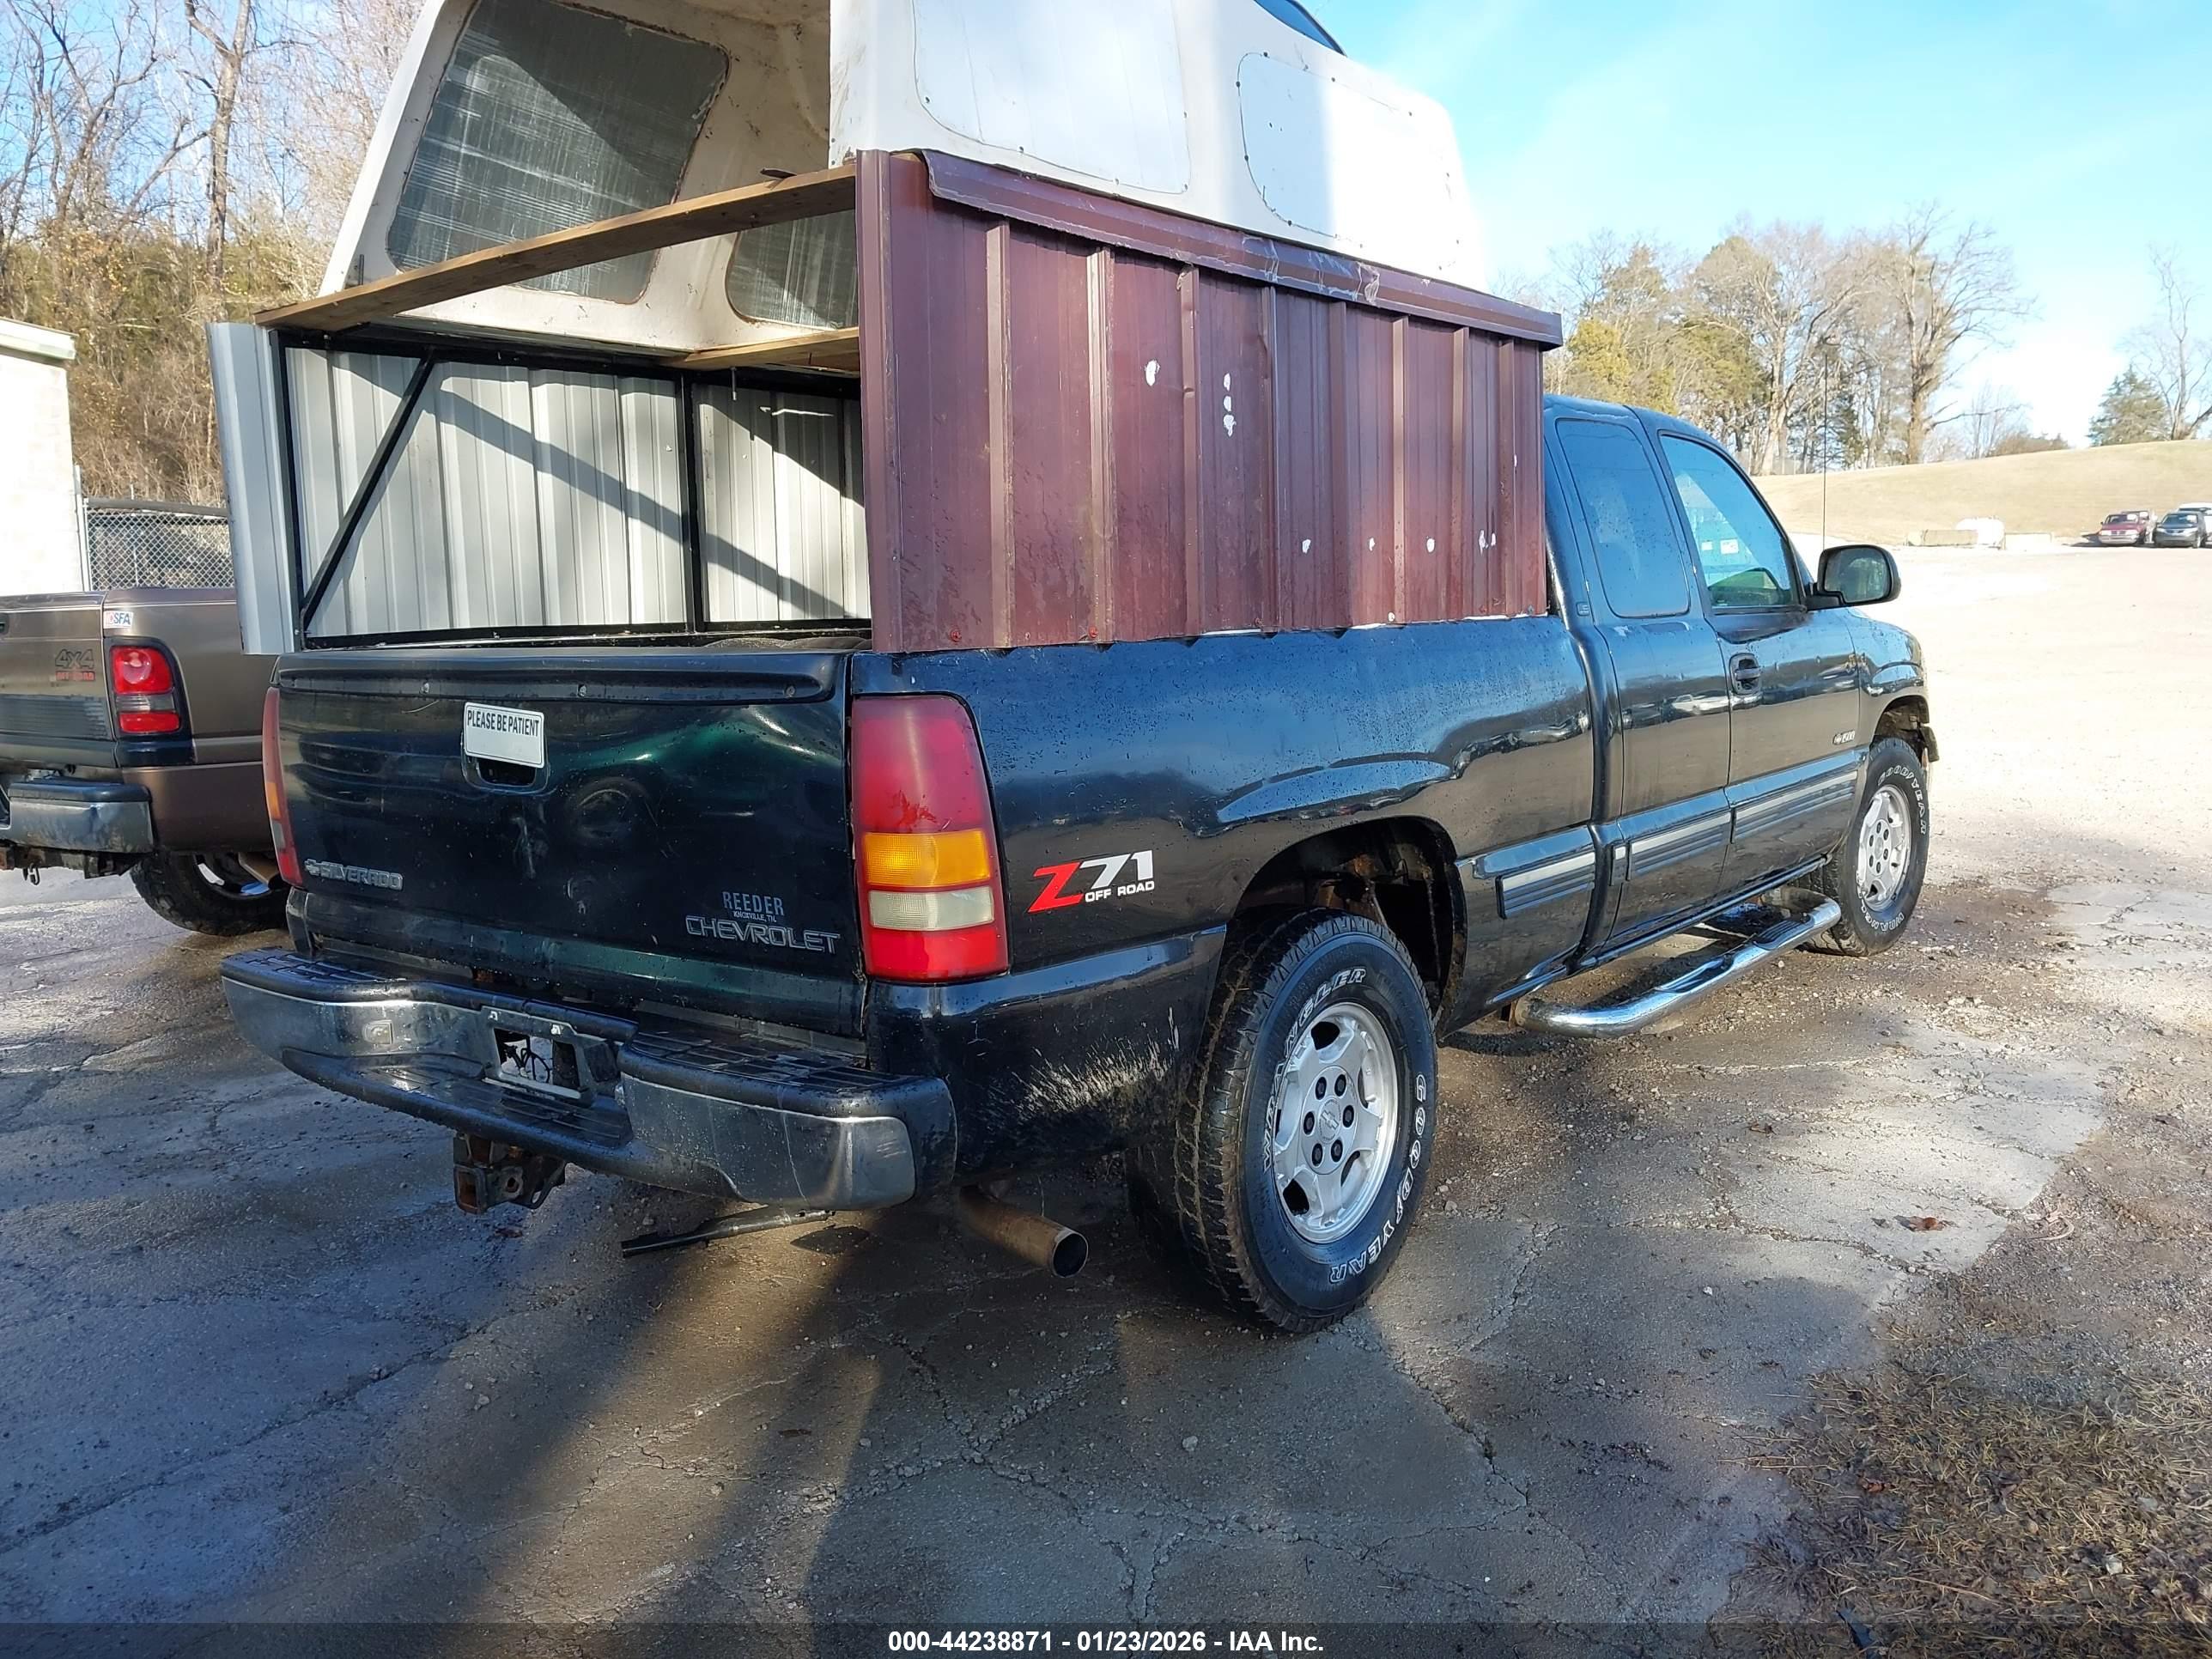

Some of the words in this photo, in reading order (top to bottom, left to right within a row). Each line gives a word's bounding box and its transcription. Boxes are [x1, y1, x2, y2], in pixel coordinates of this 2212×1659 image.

[467, 710, 495, 729] PLEASE
[496, 714, 507, 732] BE
[507, 716, 540, 738] PATIENT
[320, 861, 404, 890] SILVERADO
[1027, 849, 1154, 913] Z71
[1085, 889, 1112, 902] OFF
[1117, 880, 1155, 896] ROAD
[722, 890, 785, 916] REEDER
[685, 915, 841, 954] CHEVROLET
[1263, 967, 1367, 1174] WRANGLER
[1328, 1072, 1426, 1284] GOODYEAR
